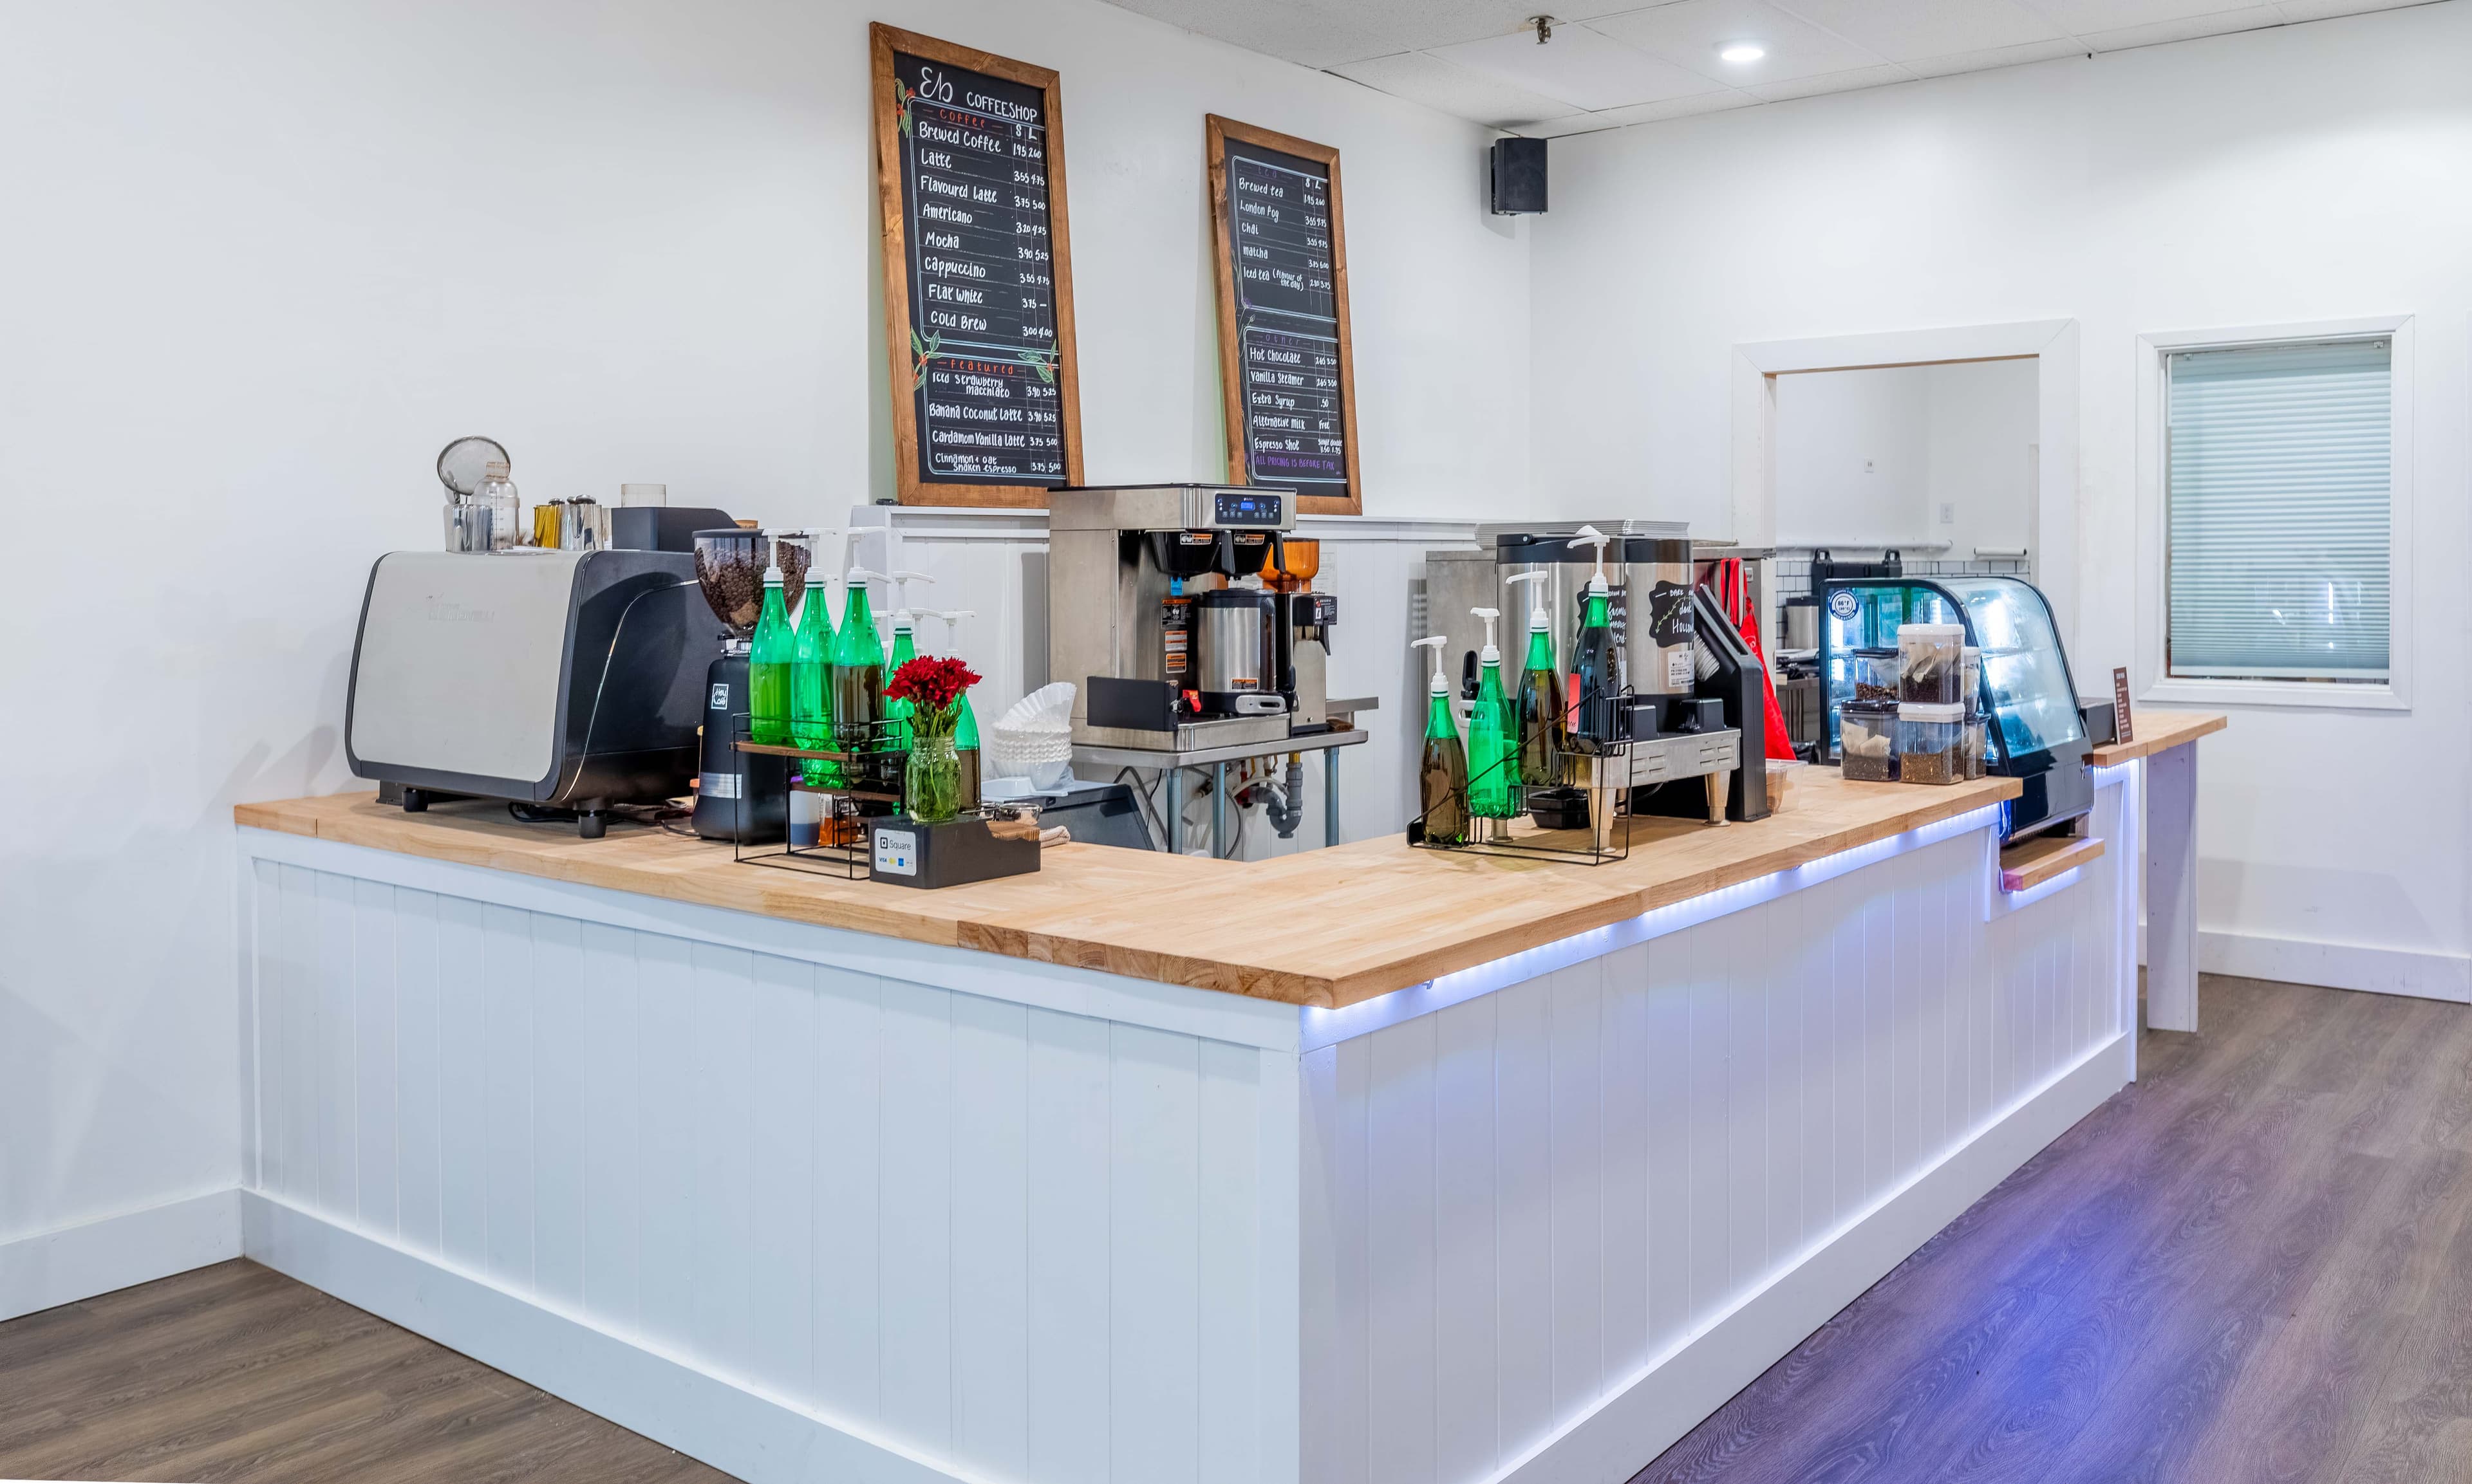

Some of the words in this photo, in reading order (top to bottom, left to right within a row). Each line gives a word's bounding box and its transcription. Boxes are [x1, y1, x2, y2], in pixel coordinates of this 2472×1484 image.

[919, 121, 959, 145] Brewed
[963, 131, 1002, 153] Coffee
[1029, 127, 1037, 140] L
[921, 148, 951, 169] Latte
[921, 175, 968, 198] Flavoured
[1239, 177, 1268, 194] Brewed
[923, 203, 973, 224] Americano
[1240, 199, 1265, 216] London
[1242, 222, 1259, 235] Chai
[925, 231, 959, 248] Mocha
[925, 256, 986, 279] Cappuccino
[1244, 266, 1257, 279] Iced
[929, 284, 953, 301] Flat
[931, 310, 956, 327] Cold
[961, 315, 987, 331] Brew
[1250, 347, 1265, 360] Hot
[1268, 349, 1301, 364] Chocolate
[933, 372, 950, 384] Iced
[1251, 370, 1275, 383] Vanilla
[1278, 373, 1304, 385] Steamer
[1252, 392, 1271, 404] Extra
[1275, 394, 1295, 411] Syrup
[929, 403, 960, 420] Banana
[963, 406, 998, 421] Coconut
[1253, 415, 1289, 428] Alternative
[932, 430, 974, 444] Cardamom
[975, 432, 1002, 447] Vanilla
[1254, 437, 1283, 453] Espresso
[935, 453, 973, 464] Cinnamon
[1255, 456, 1266, 465] ALL
[1268, 456, 1289, 467] PRICING
[1299, 458, 1320, 469] BEFORE
[890, 840, 911, 851] Square
